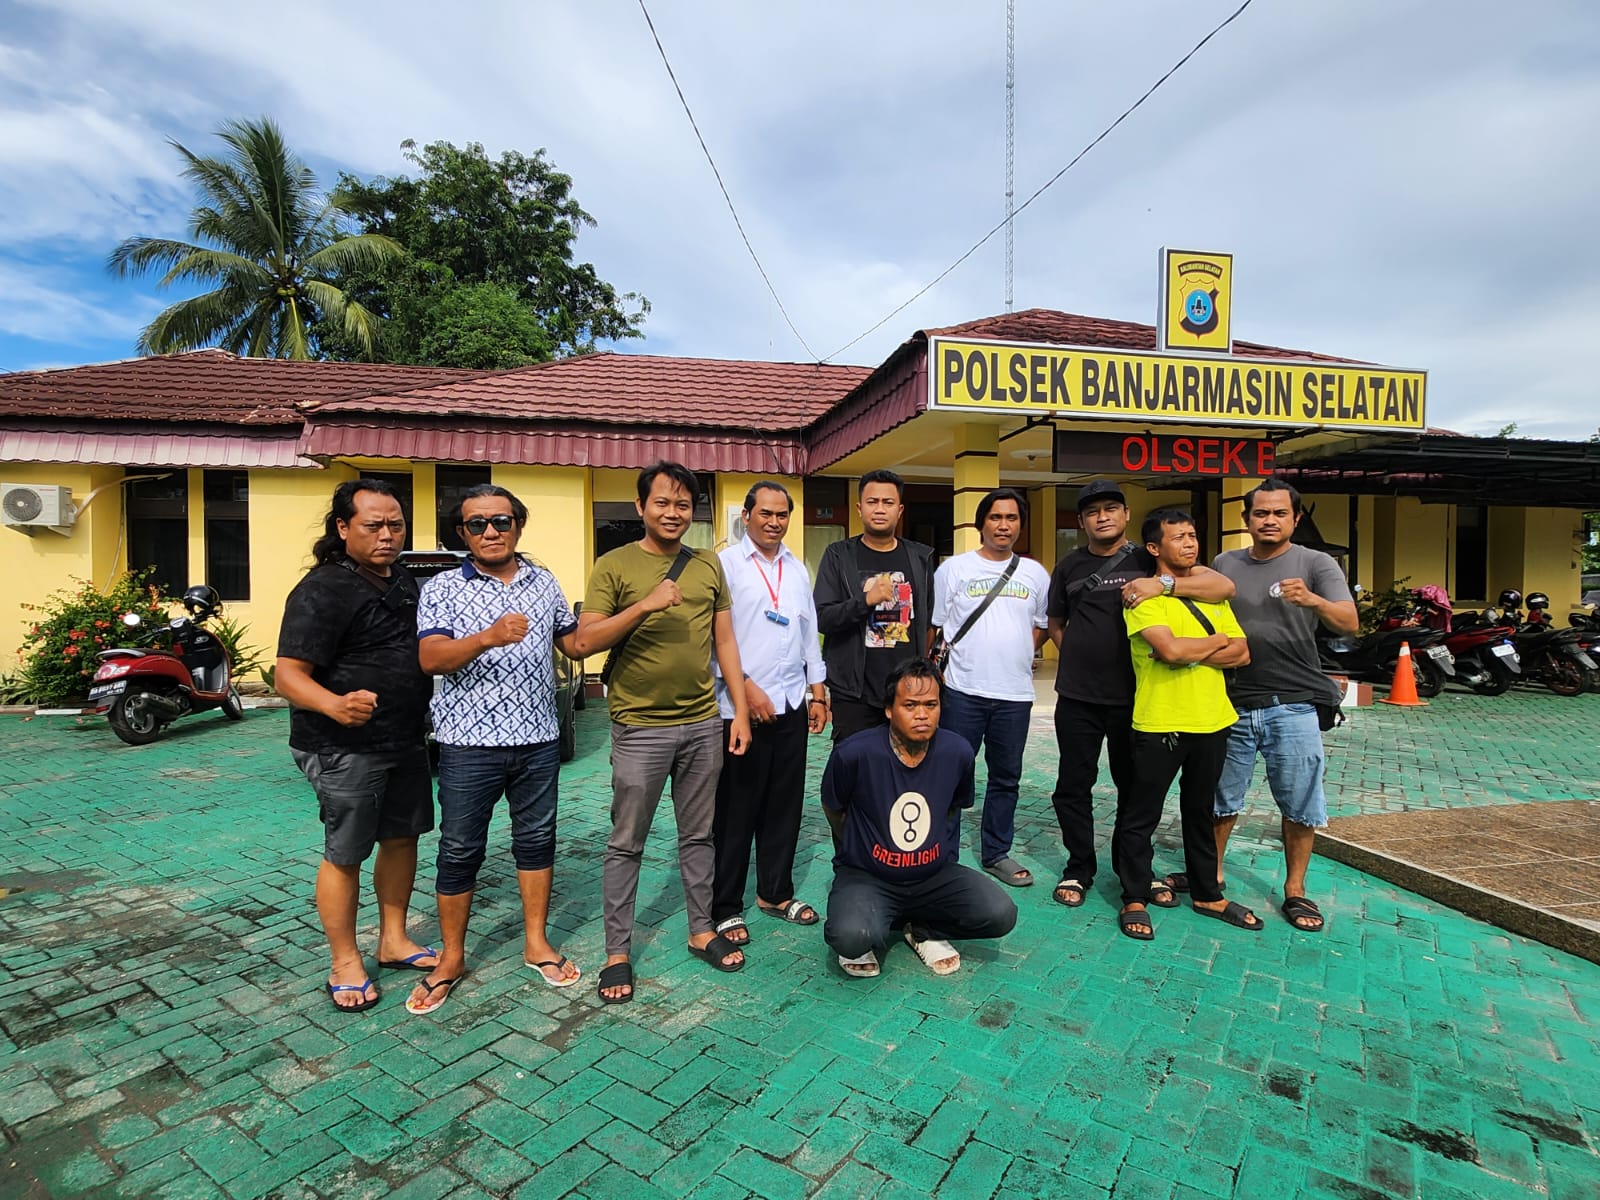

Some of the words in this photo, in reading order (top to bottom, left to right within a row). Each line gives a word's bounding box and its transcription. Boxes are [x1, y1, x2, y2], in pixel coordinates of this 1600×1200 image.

[944, 349, 1071, 405] POLSEK
[1082, 358, 1293, 417] BANJARMASIN
[1302, 371, 1419, 422] SELATAN
[1121, 436, 1248, 475] OLSEK
[872, 842, 940, 868] GREENLIGHT
